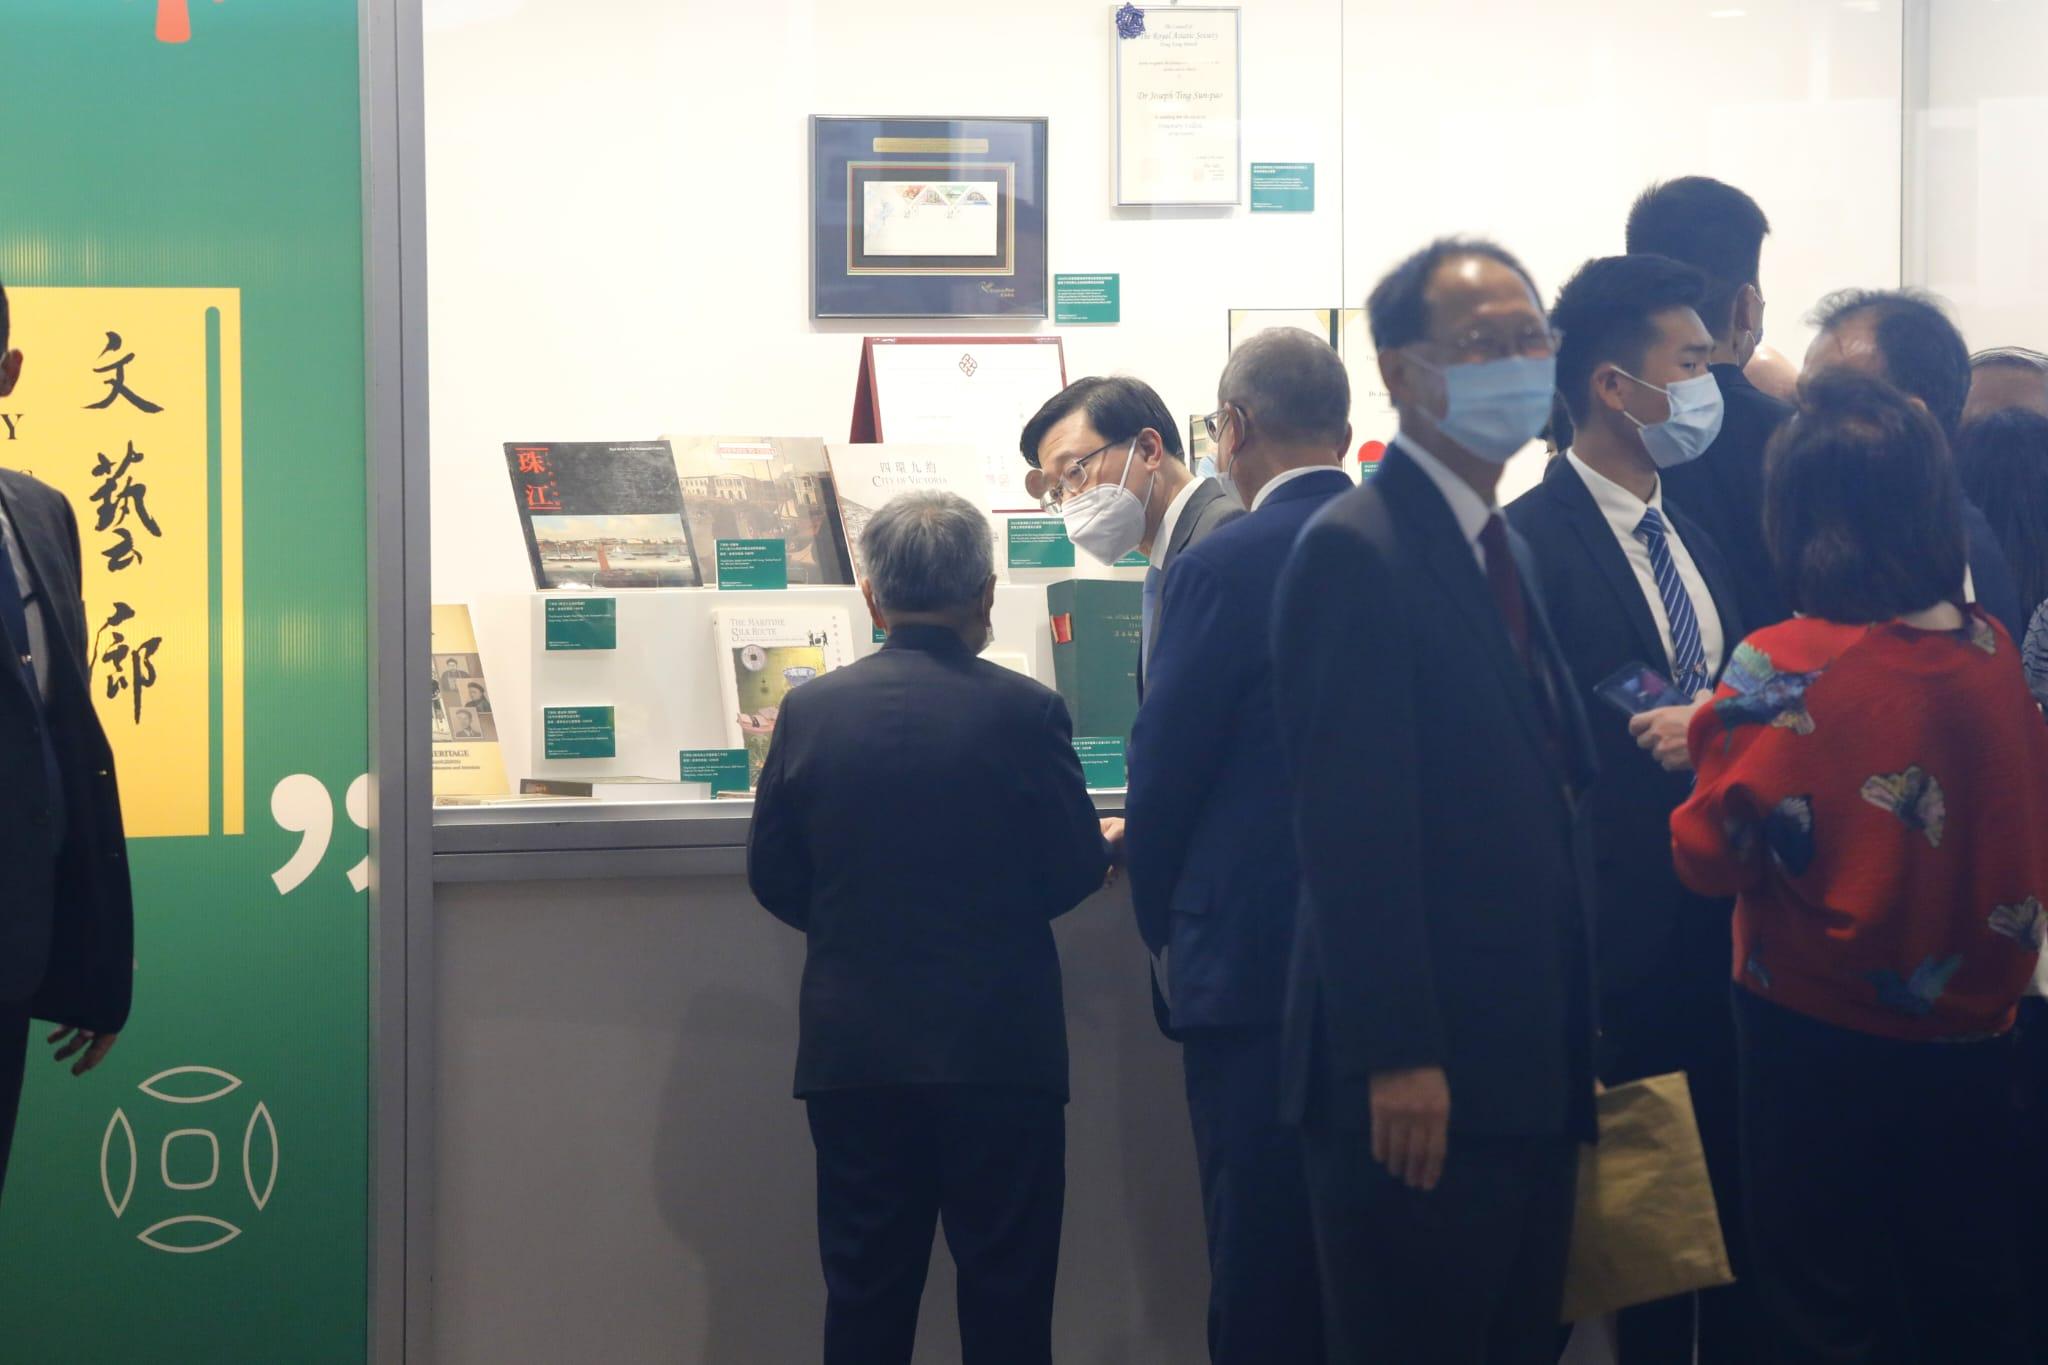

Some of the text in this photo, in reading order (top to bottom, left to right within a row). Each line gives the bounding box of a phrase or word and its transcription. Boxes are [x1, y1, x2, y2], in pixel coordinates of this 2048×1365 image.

[81, 330, 166, 726] 文藝廊
[517, 451, 554, 505] 珠江
